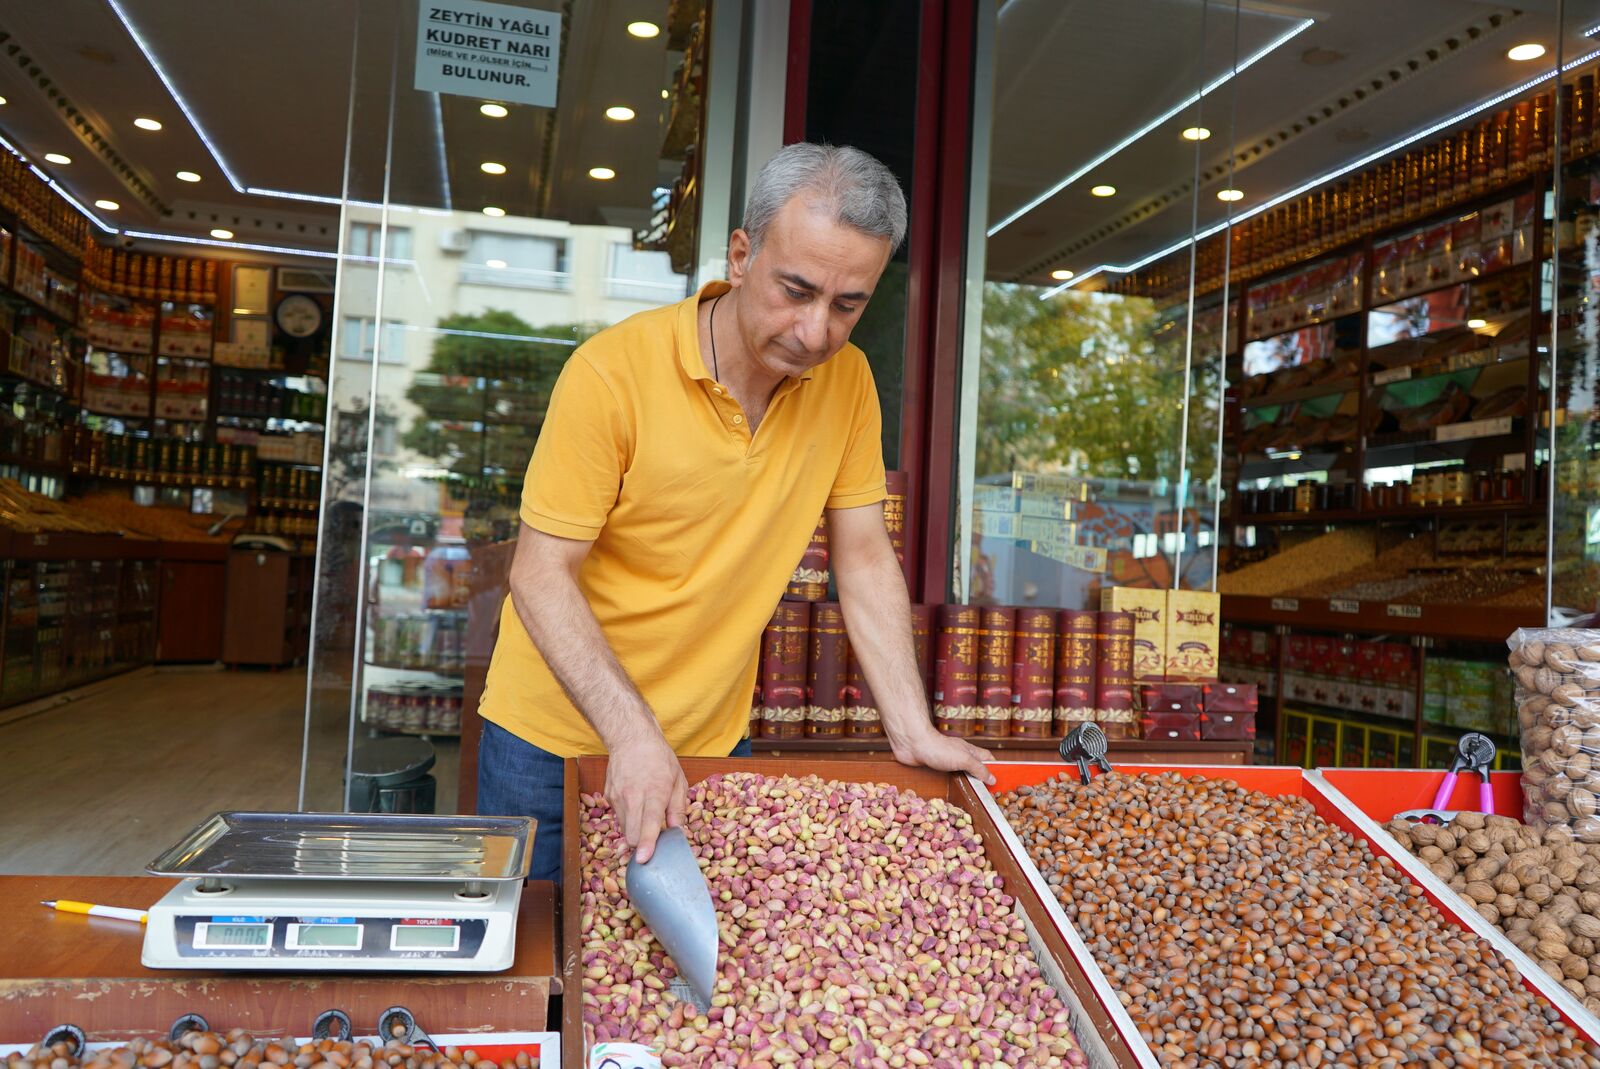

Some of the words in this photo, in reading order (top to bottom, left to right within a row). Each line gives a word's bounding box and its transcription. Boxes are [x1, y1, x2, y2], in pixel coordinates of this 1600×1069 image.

[429, 8, 493, 28] ZEYTİN
[499, 18, 549, 36] YAĞLI
[426, 28, 501, 50] KUDRET
[507, 41, 550, 58] NARI
[456, 51, 468, 60] VE
[442, 64, 531, 87] BULUNUR.
